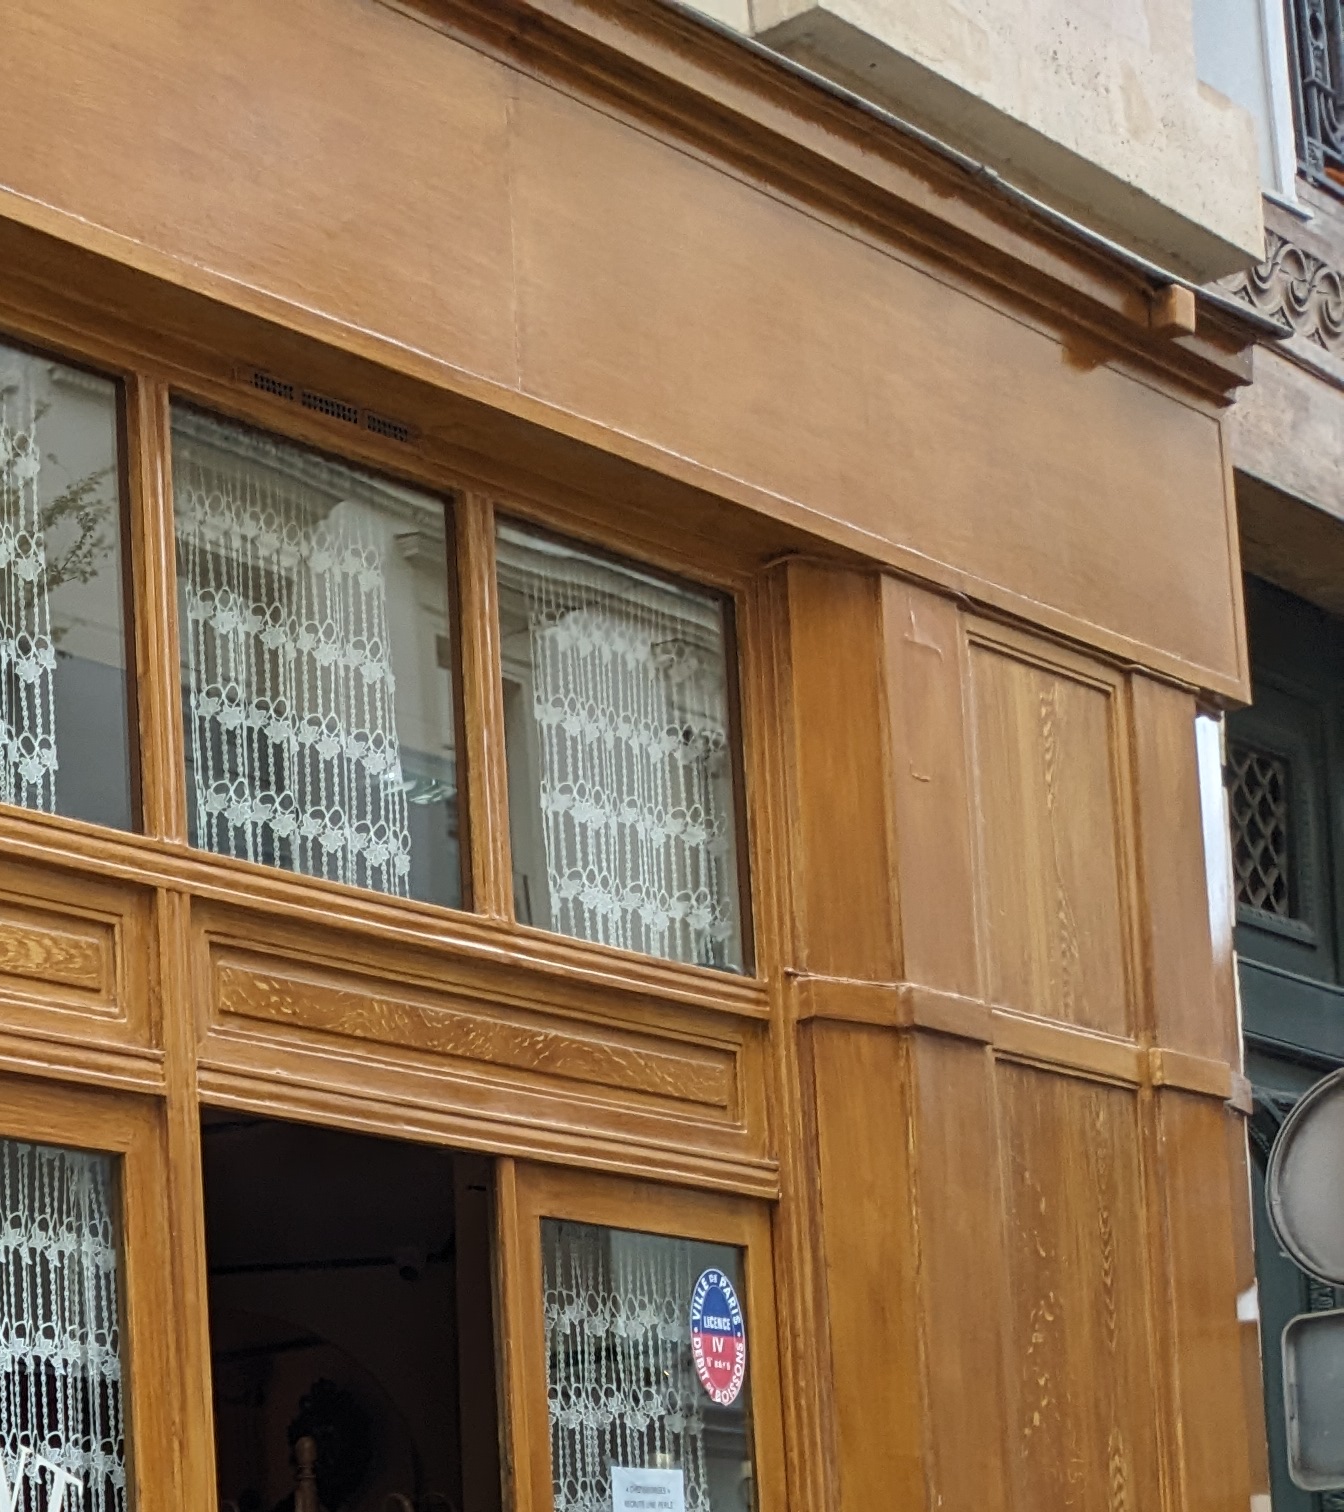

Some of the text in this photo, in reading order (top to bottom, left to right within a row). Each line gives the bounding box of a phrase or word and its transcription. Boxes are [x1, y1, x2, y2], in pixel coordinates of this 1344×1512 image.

[692, 1277, 709, 1320] VILLE
[719, 1276, 742, 1326] PARIS
[703, 1315, 731, 1331] LICENCE
[712, 1336, 724, 1353] IV
